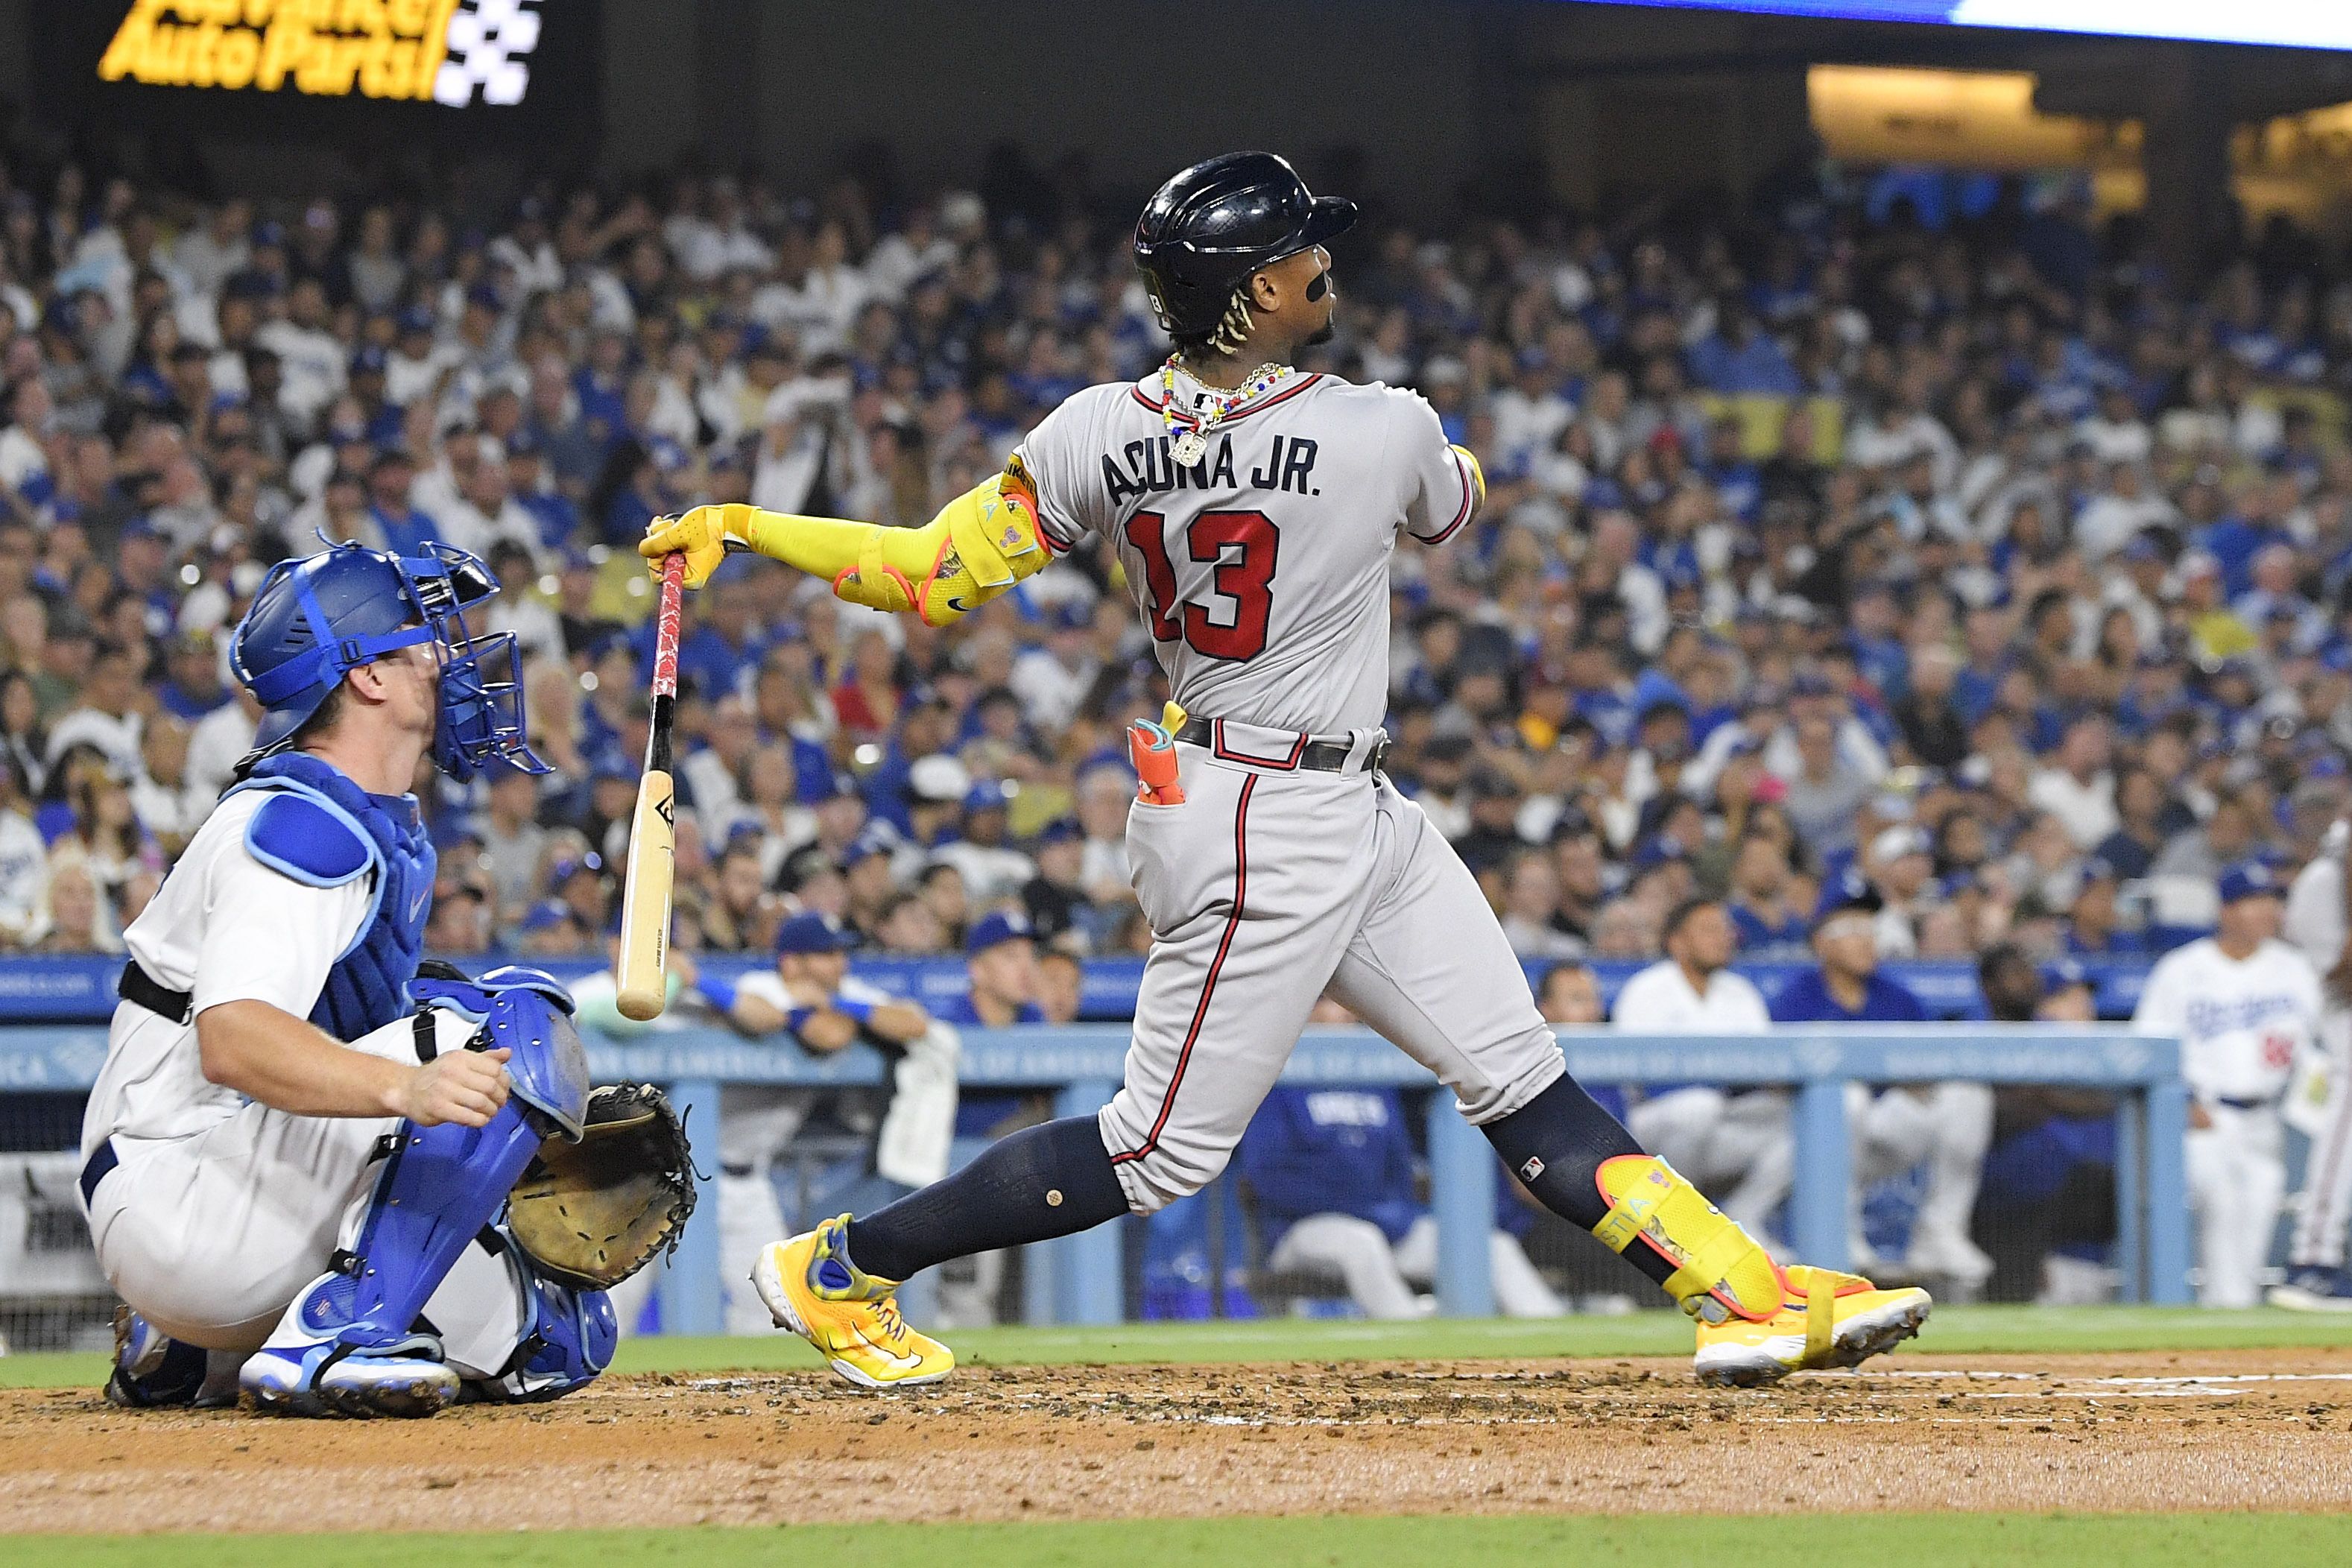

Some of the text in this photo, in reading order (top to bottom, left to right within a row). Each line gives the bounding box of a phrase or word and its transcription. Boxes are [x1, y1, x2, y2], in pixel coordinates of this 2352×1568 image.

[98, 10, 419, 100] Auto Parts
[1251, 434, 1321, 496] JR.
[1124, 510, 1280, 664] 13
[314, 1299, 330, 1317] 16
